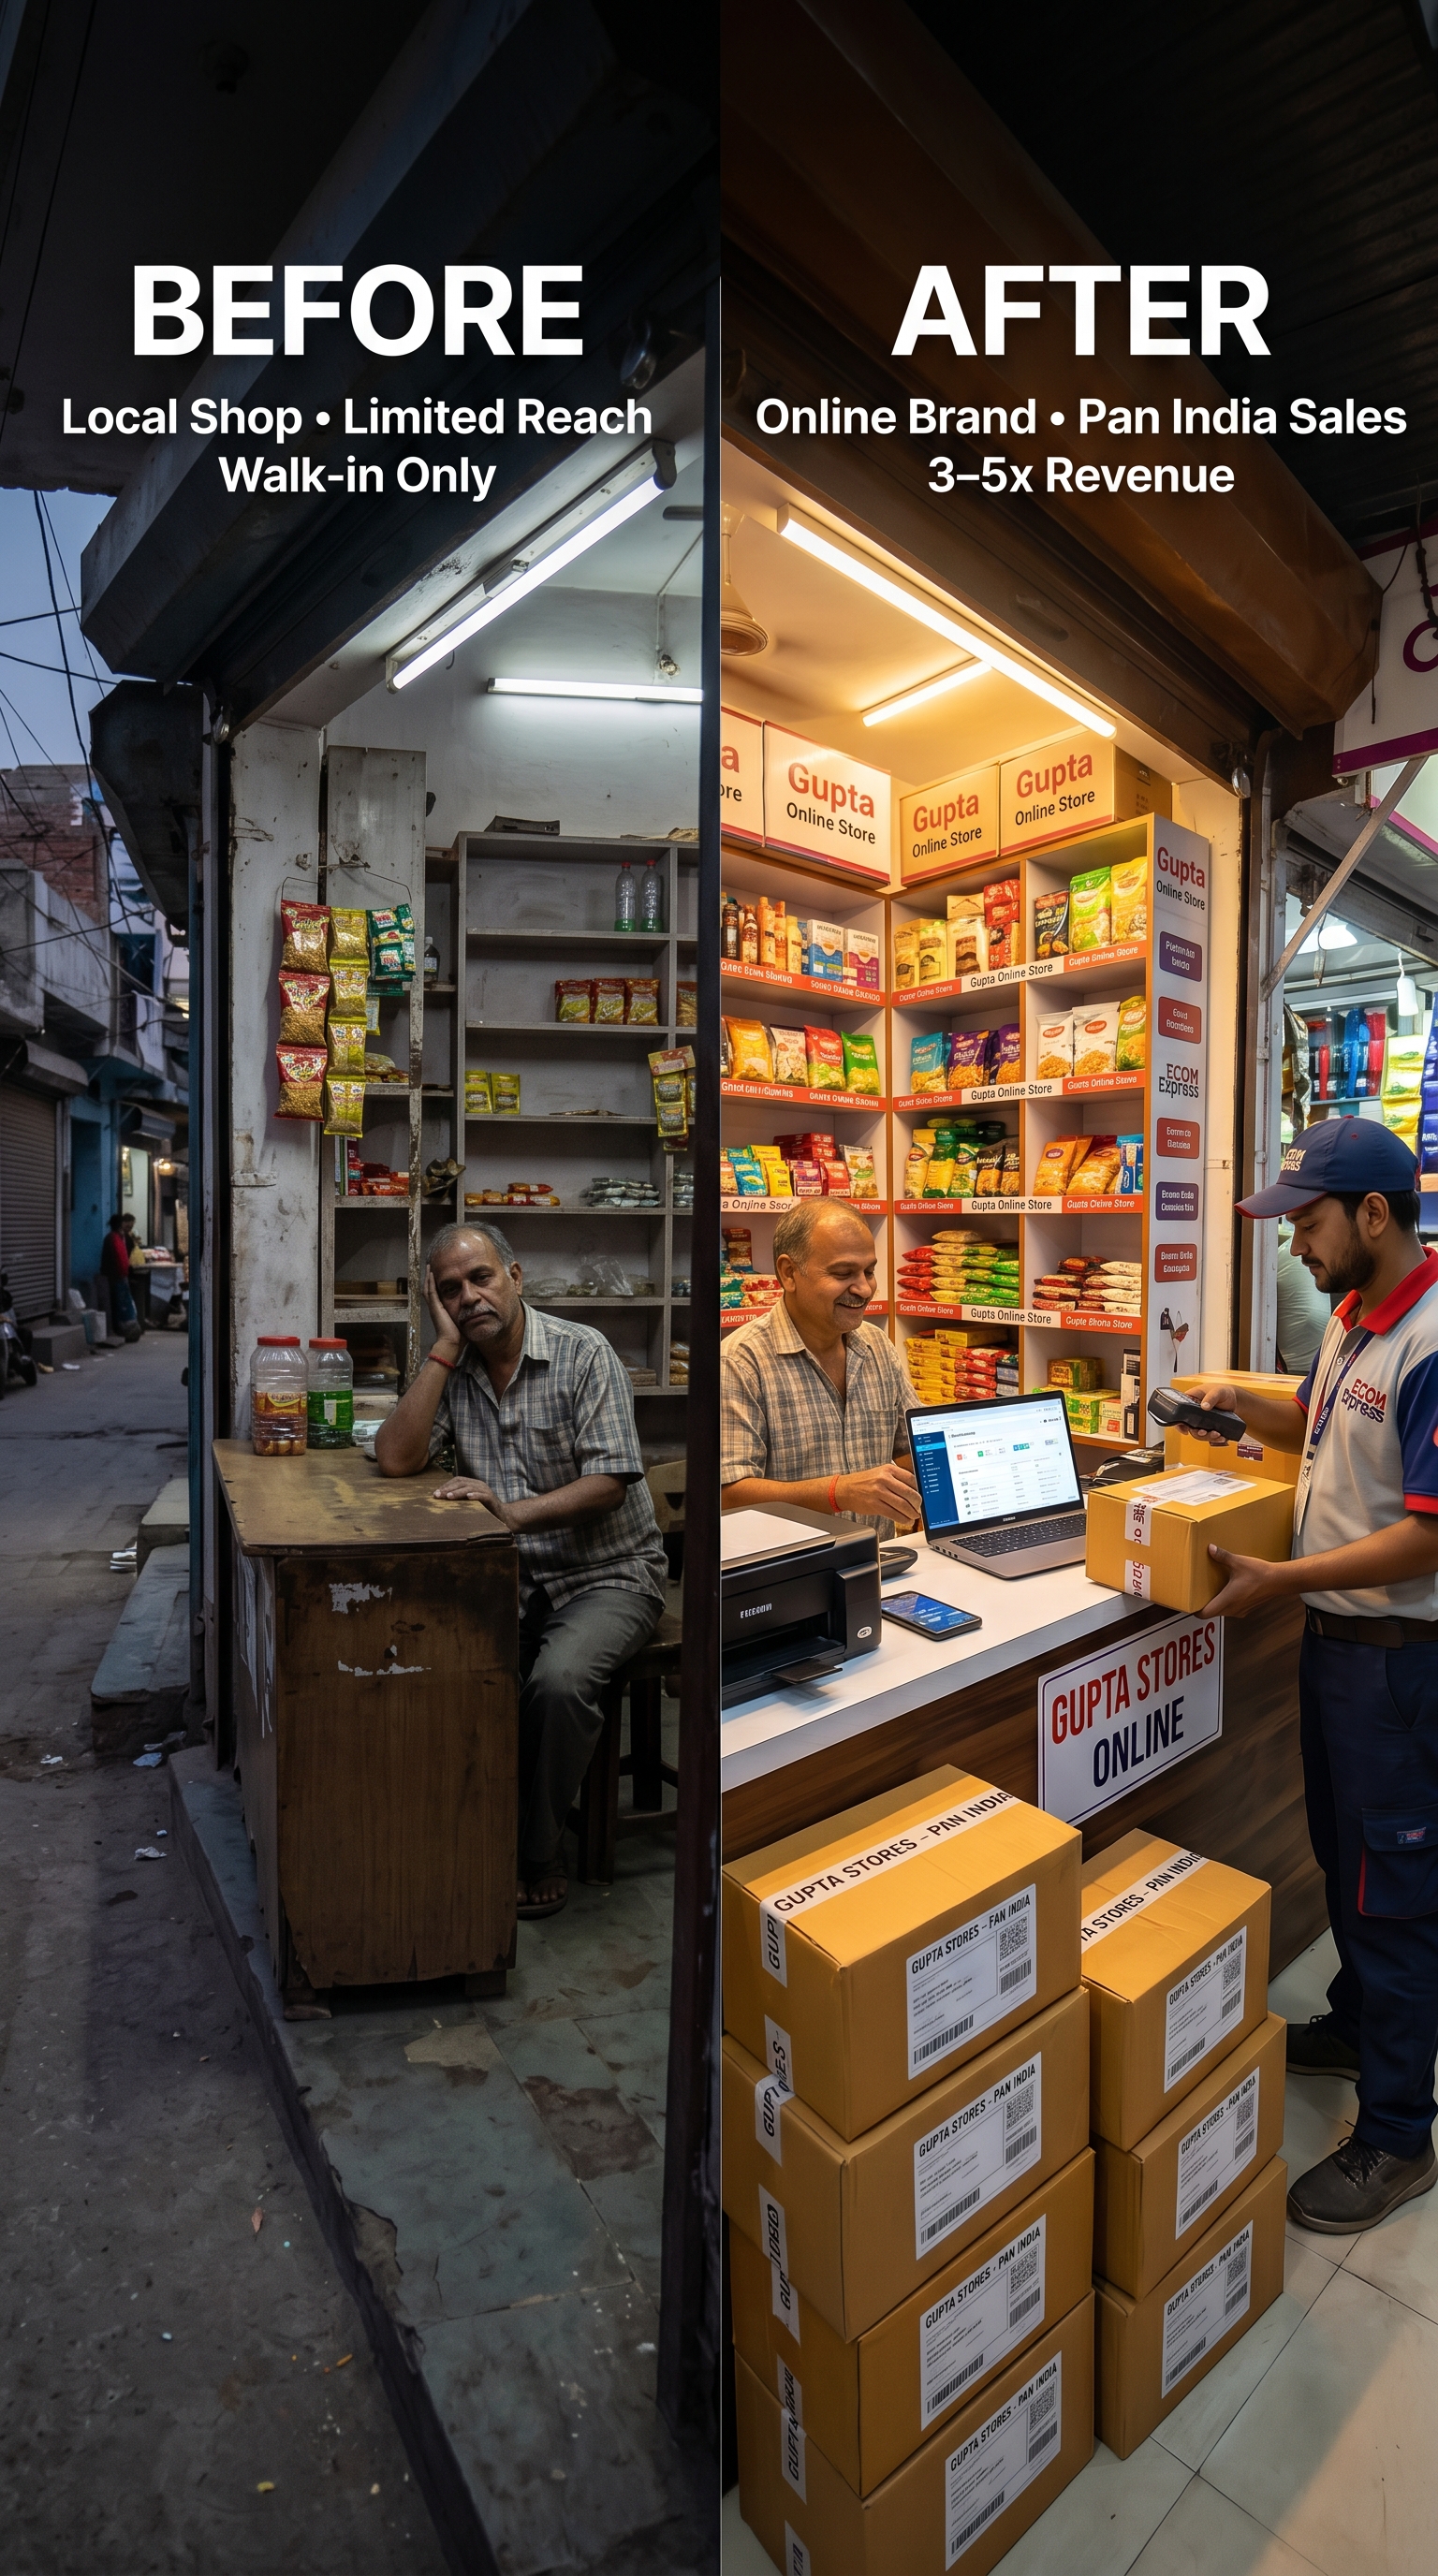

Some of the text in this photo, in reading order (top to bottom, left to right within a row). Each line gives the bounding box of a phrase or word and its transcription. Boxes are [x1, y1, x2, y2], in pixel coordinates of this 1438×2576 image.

[788, 762, 874, 818] Gupta
[1016, 754, 1093, 798] Gupta
[786, 802, 875, 844] Online Store
[913, 793, 979, 833] Gupta
[1015, 790, 1095, 826] Online Store
[912, 827, 982, 857] Online Store
[1157, 846, 1205, 888] Gupta
[1156, 880, 1182, 901] Online
[970, 973, 995, 988] Gupta
[1028, 962, 1053, 975] Store
[971, 1088, 996, 1102] Gupta
[998, 1084, 1026, 1098] Online
[1028, 1083, 1052, 1096] Store
[1167, 1063, 1198, 1085] ECOM
[971, 1198, 1052, 1214] Gupta Online Store
[997, 1309, 1026, 1323] Online
[1028, 1311, 1051, 1325] Store
[1112, 1319, 1133, 1329] Store
[1051, 1621, 1215, 1745] GUPTA STORES
[1093, 1695, 1184, 1788] ONLINE
[773, 1874, 845, 1912] GUPTA
[842, 1837, 918, 1879] STORES
[927, 1814, 968, 1837] PAN
[961, 1790, 1014, 1820] INDIA
[1092, 1894, 1145, 1929] STORES
[1146, 1872, 1175, 1892] PAN
[911, 1947, 944, 1974] GUPTA
[945, 1924, 979, 1954] STORES
[919, 2126, 950, 2158] GUPTA
[951, 2099, 986, 2134] STORES
[993, 2080, 1011, 2103] PAN
[925, 2296, 956, 2329] GUPTA
[998, 2246, 1016, 2270] PAN
[1017, 2226, 1041, 2255] INDIA
[950, 2362, 1057, 2472] GUPTA STORES PAN INDIA
